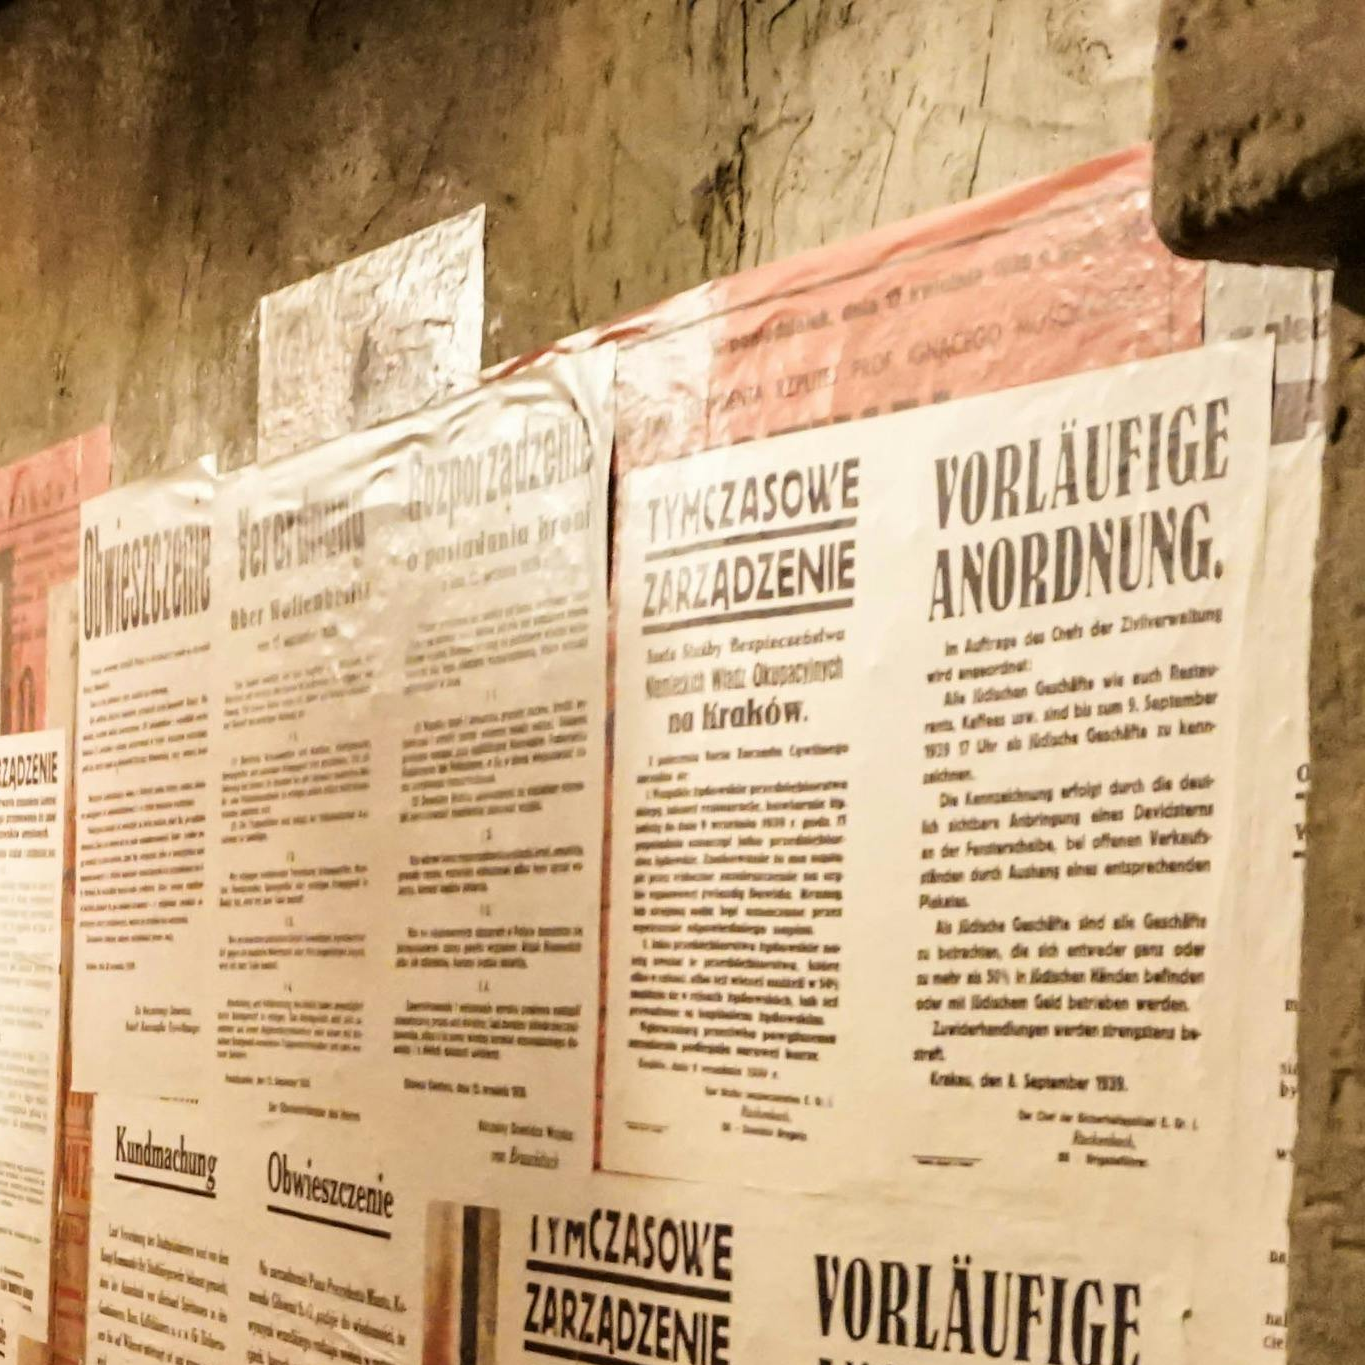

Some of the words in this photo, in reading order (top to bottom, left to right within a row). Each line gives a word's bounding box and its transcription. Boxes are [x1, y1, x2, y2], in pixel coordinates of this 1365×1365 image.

[647, 457, 860, 543] TYMCZASOWE
[934, 397, 1229, 530] VORLÄUFIGE
[83, 525, 212, 642] Obwieszczenie
[642, 540, 856, 618] ZARZĄDZENIE
[928, 502, 1224, 622] ANORDNUNG.
[668, 710, 694, 734] na
[702, 697, 809, 730] Kraków.
[116, 1126, 218, 1190] Kundmachung
[267, 1151, 395, 1219] Obwieszczenie
